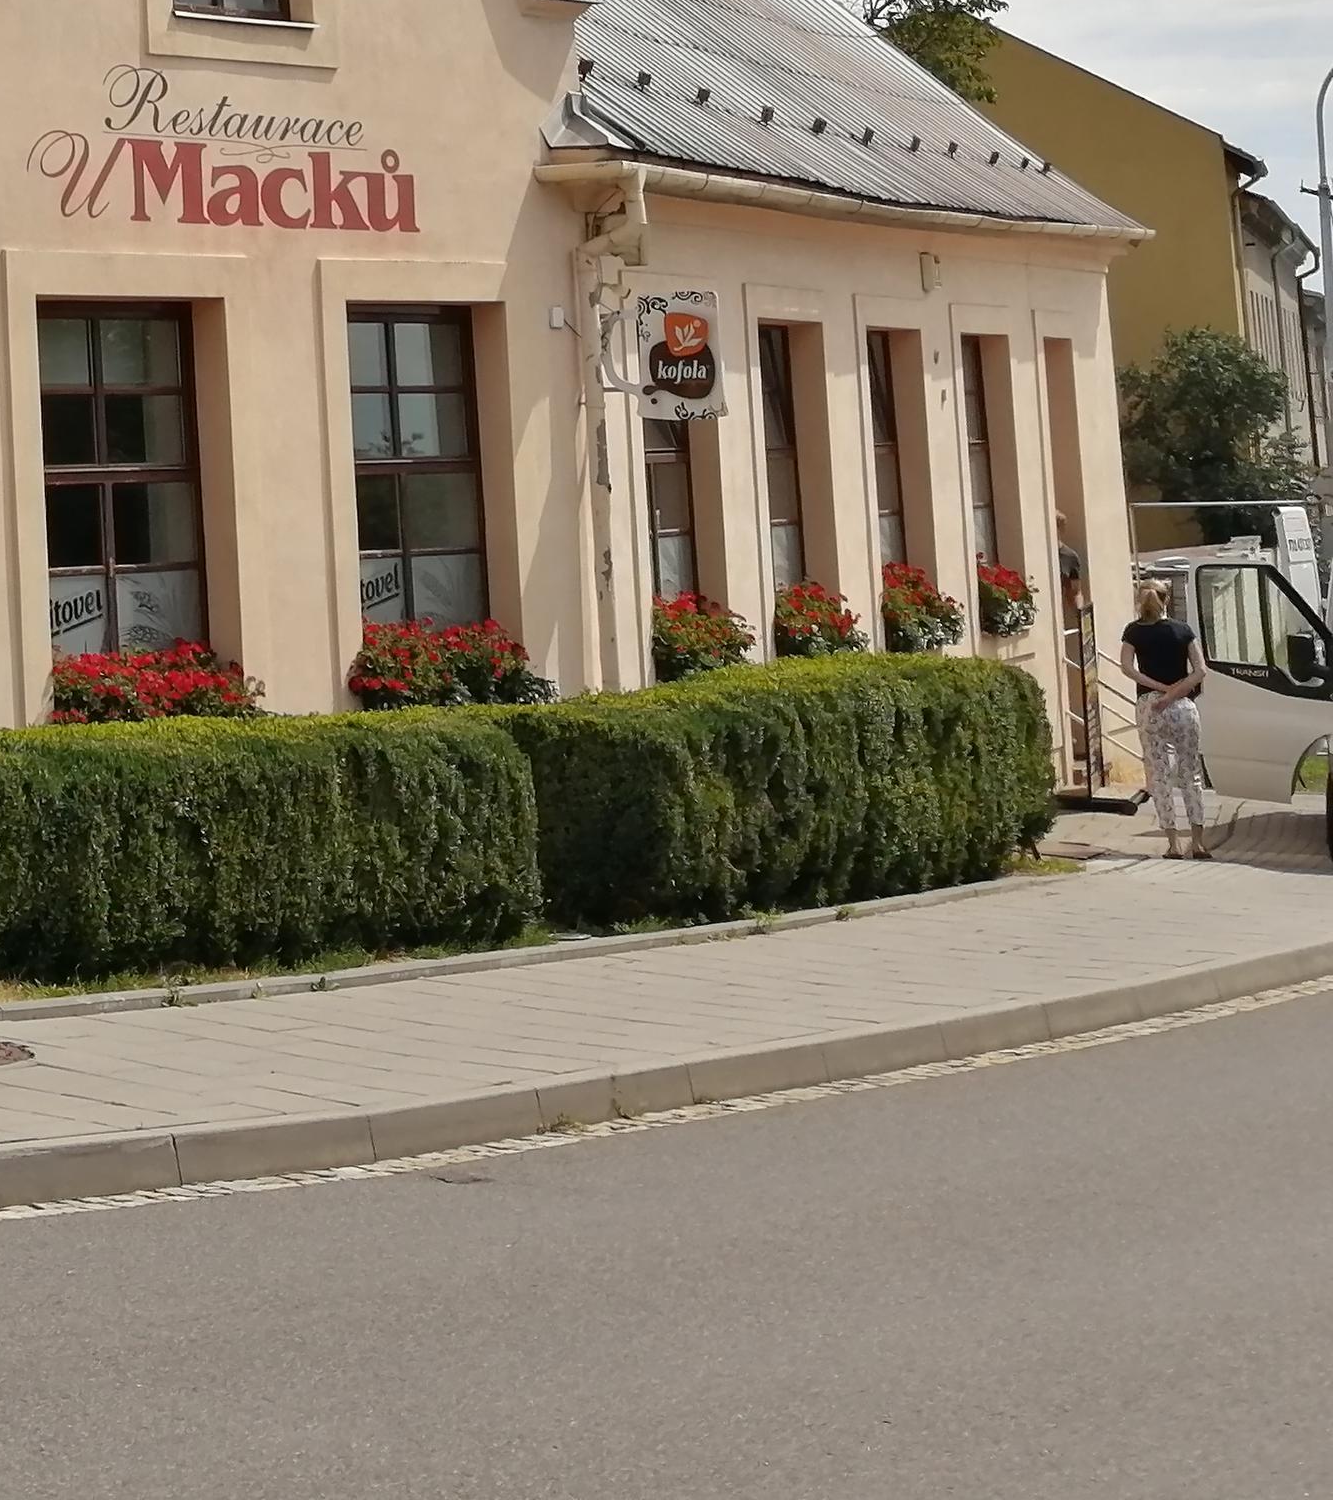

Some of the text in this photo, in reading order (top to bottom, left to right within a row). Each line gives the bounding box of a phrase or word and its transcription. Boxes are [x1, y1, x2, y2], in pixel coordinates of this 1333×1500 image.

[102, 64, 365, 147] Restaurace
[26, 130, 421, 233] U Macků
